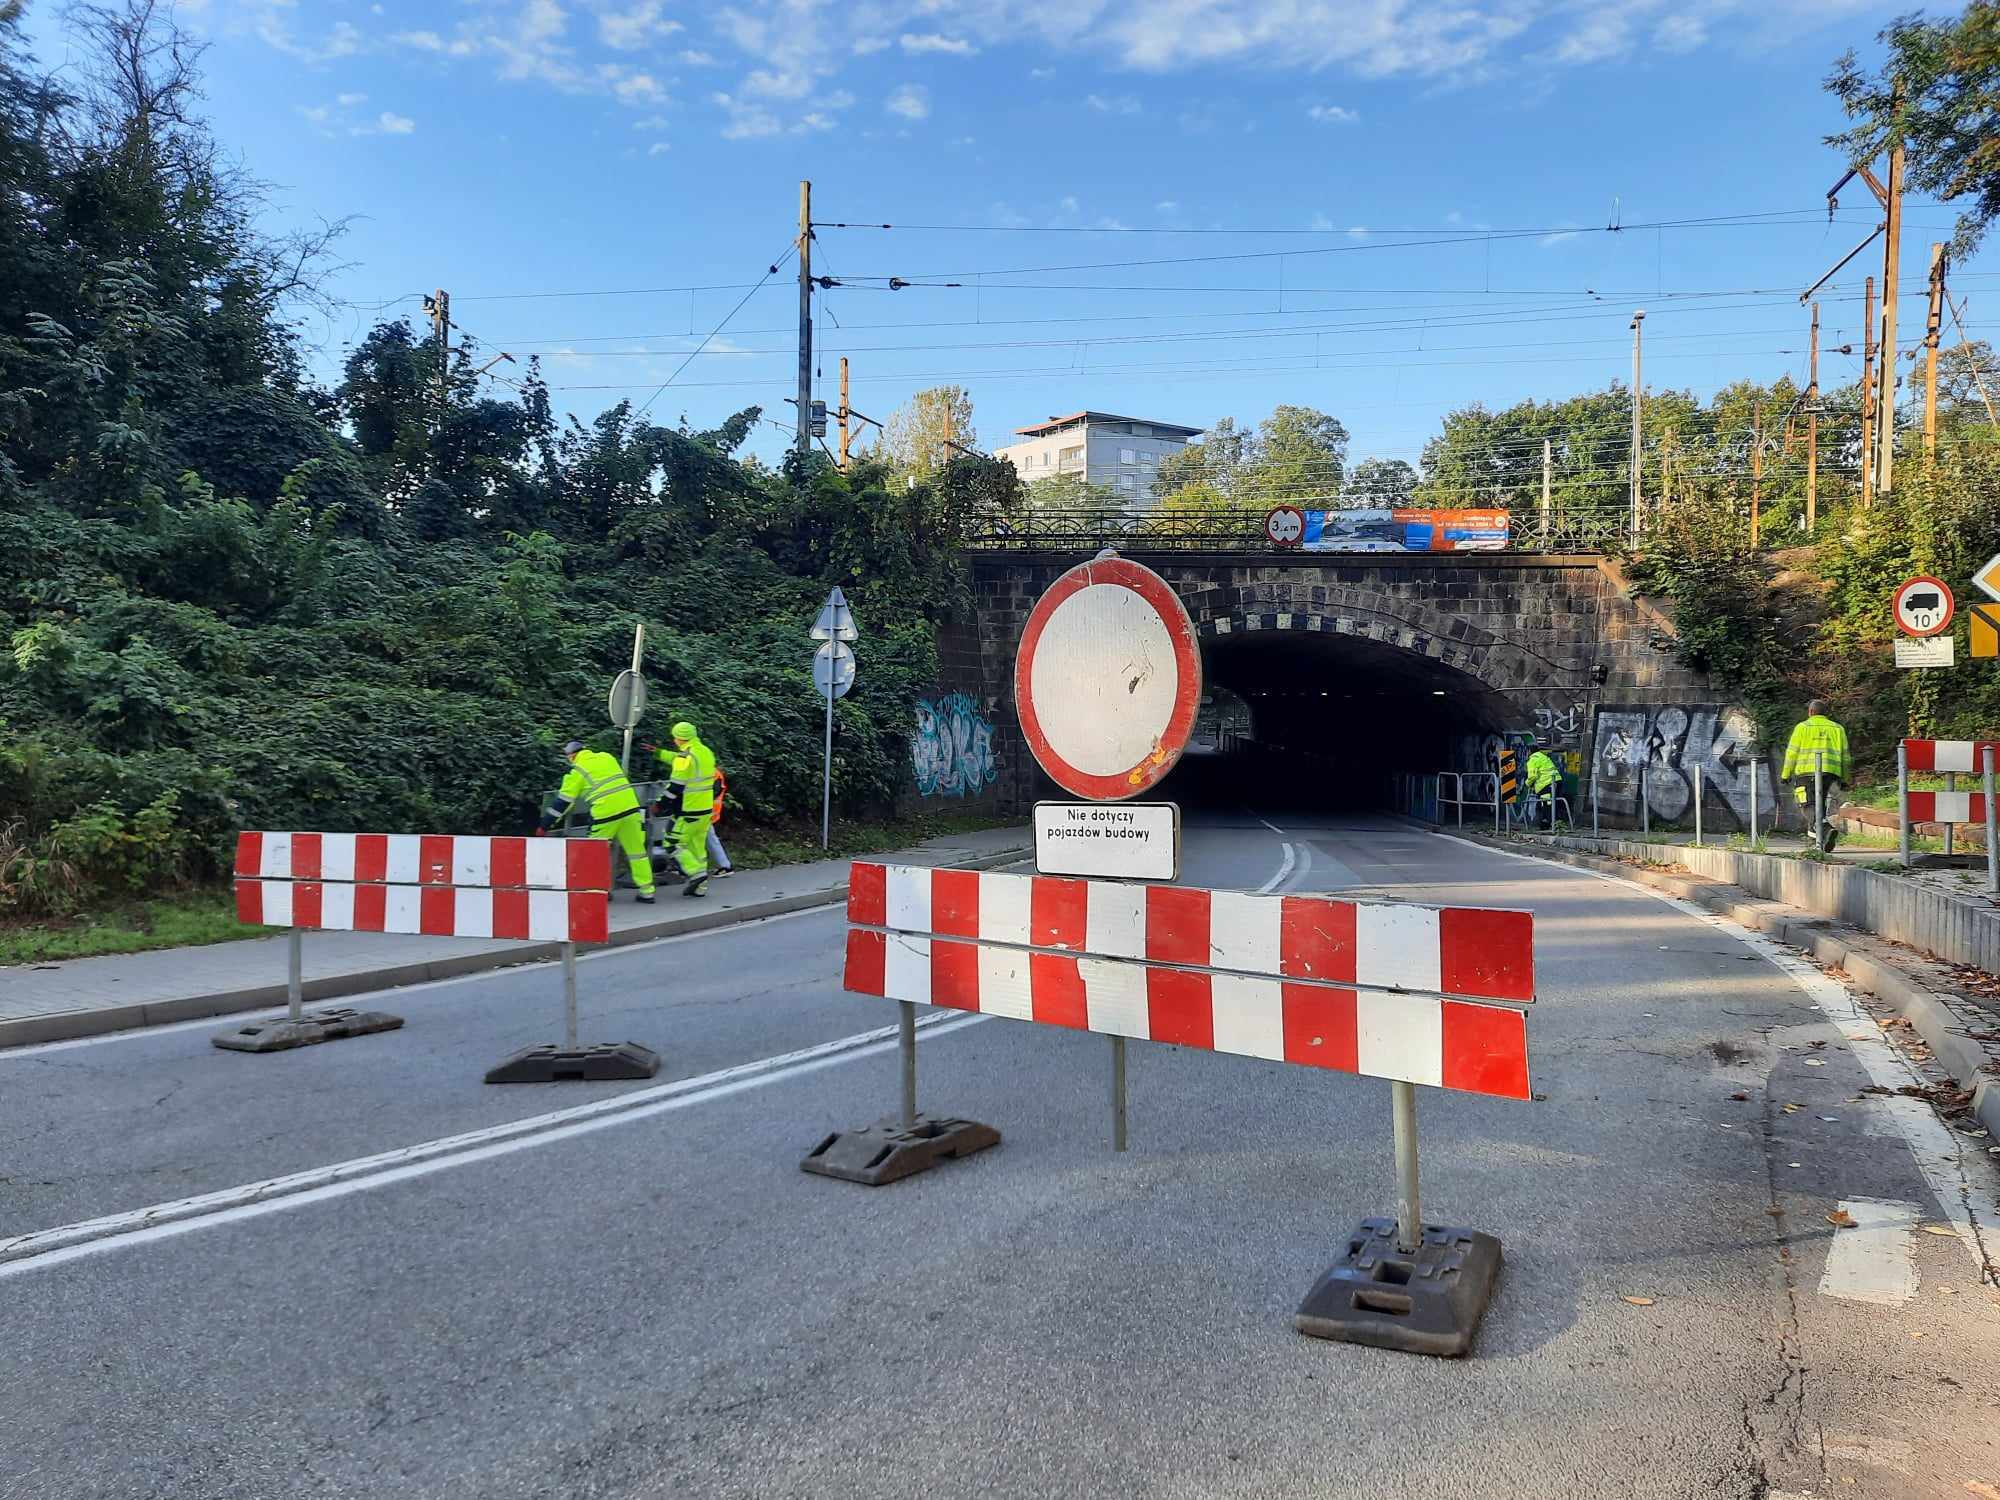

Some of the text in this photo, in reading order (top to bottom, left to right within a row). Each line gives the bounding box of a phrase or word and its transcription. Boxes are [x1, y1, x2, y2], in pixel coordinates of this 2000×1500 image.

[1914, 614, 1931, 627] 10
[1067, 809, 1134, 824] Nie dotyczy
[1047, 825, 1150, 842] pojazdów budowy
